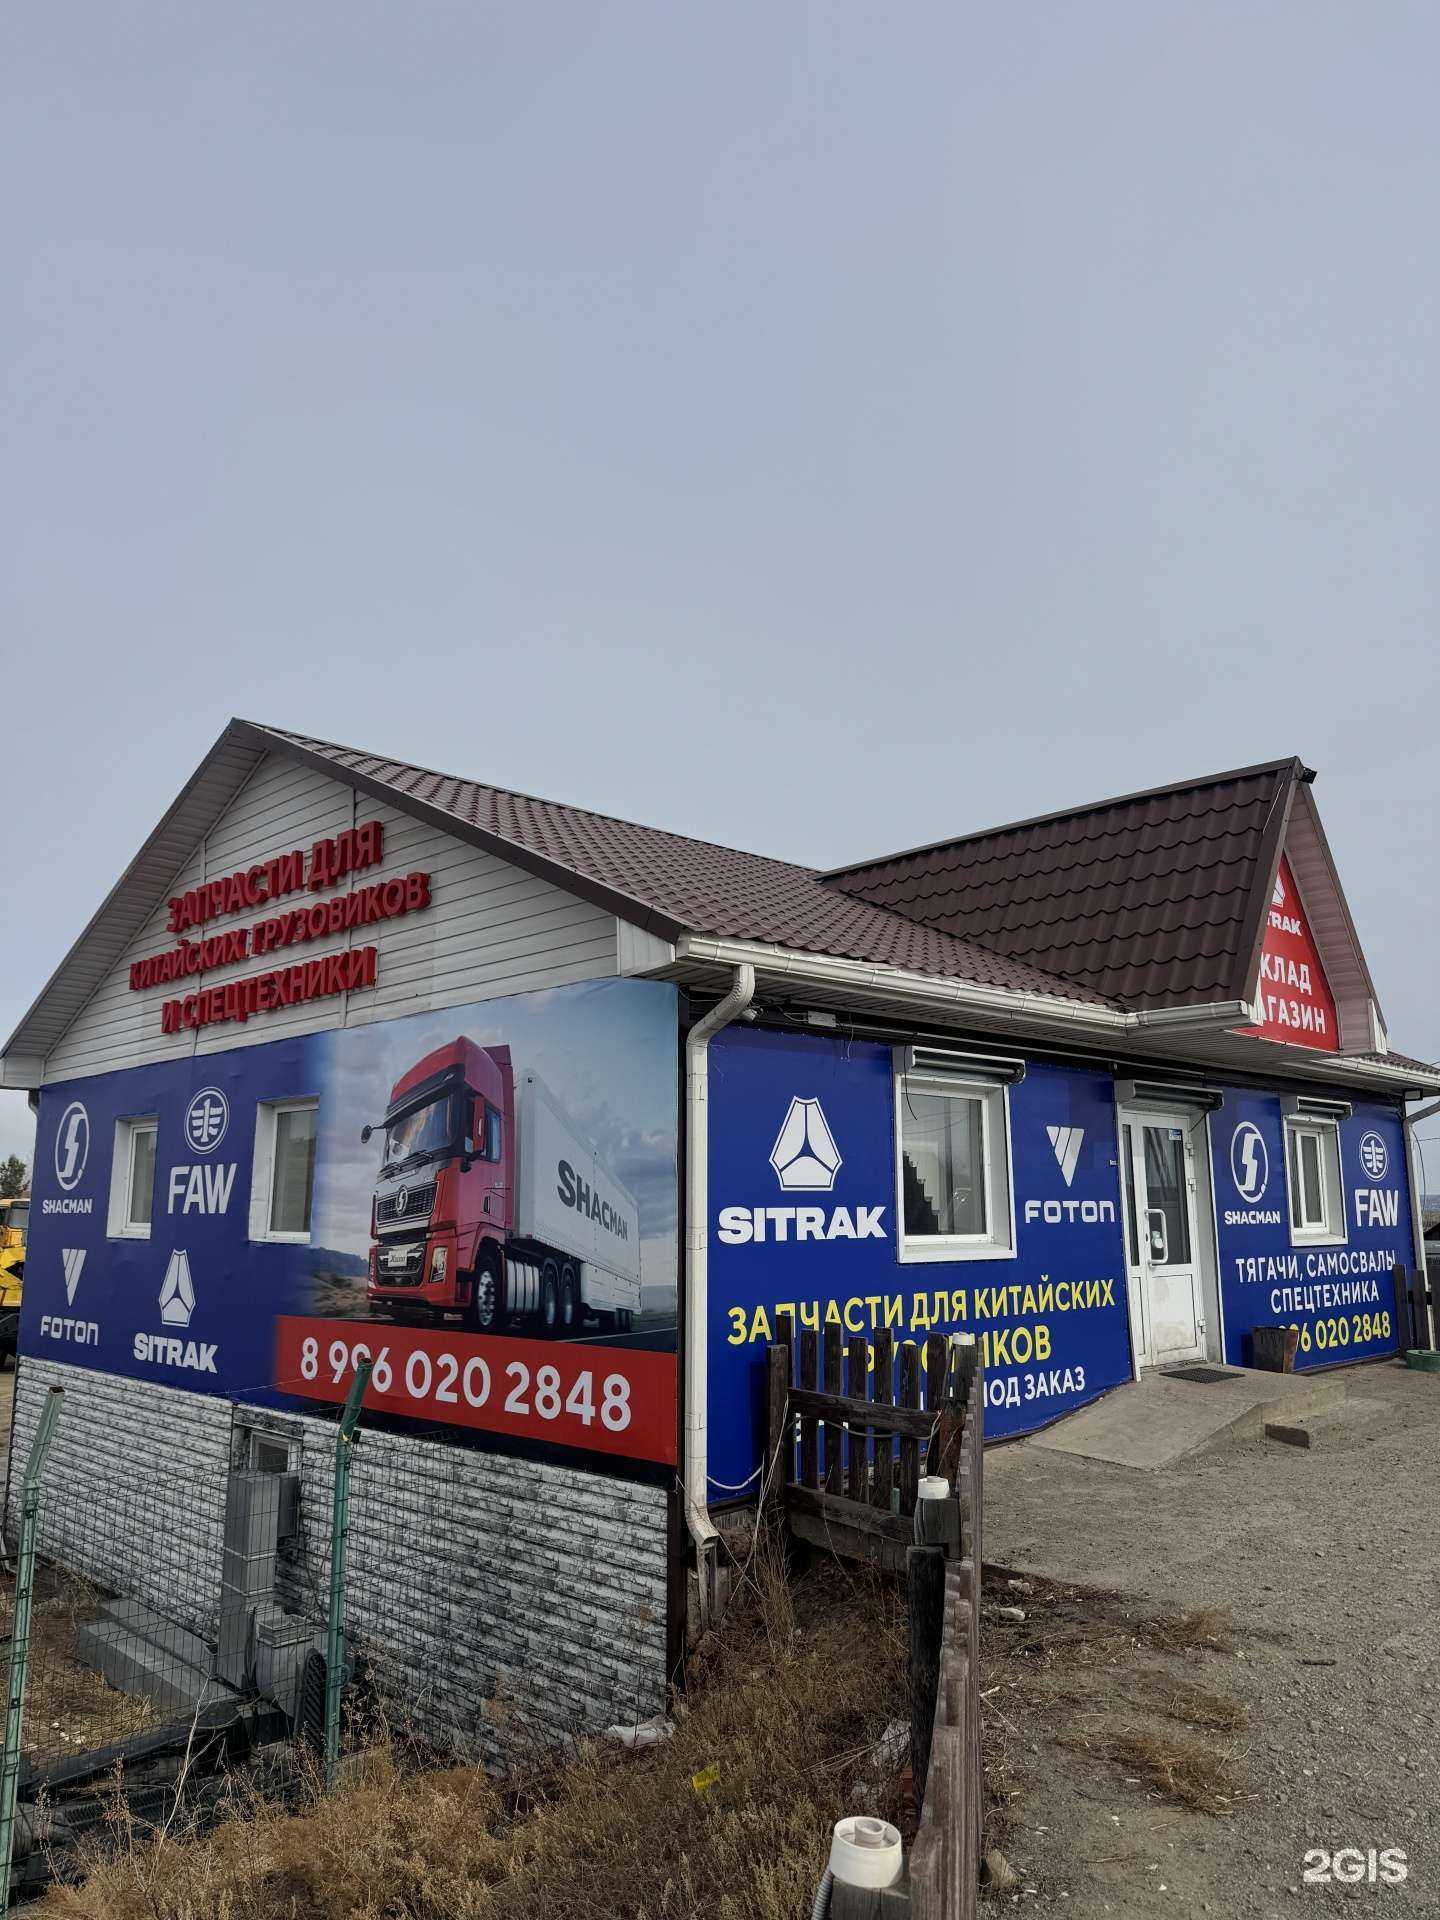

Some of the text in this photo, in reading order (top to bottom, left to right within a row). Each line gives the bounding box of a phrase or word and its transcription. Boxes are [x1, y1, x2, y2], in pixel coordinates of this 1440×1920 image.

[167, 821, 384, 932] ЗАПЧАСТИ ДЛЯ
[129, 872, 431, 990] КИТАЙСКИХ ГРУЗОВИКОВ
[162, 946, 378, 1034] И СПЕЦТЕХНИКИ
[1260, 951, 1312, 996] КЛАД
[1262, 995, 1326, 1034] ГАЗИН
[42, 1198, 92, 1214] SHACMAN
[167, 1163, 237, 1214] FAW
[557, 1159, 628, 1241] SHACMAN
[1354, 1189, 1399, 1227] FAW
[718, 1206, 888, 1244] SITRAK
[1024, 1200, 1115, 1224] FOTON
[1224, 1210, 1281, 1224] SHACMAN
[1235, 1249, 1396, 1282] ТЯГАЧИ, САМОСВАЛЫ
[910, 1289, 967, 1332] ДЛЯ
[974, 1275, 1116, 1319] КИТАЙСКИХ
[1270, 1279, 1380, 1314] СПЕЦТЕХНИКА
[40, 1316, 99, 1346] FOTON
[1315, 1316, 1349, 1350] 020
[1352, 1311, 1391, 1343] 2848
[133, 1332, 219, 1373] SITRAK
[301, 1336, 318, 1380] 8
[405, 1350, 491, 1408] 020
[504, 1361, 632, 1432] 2848
[1023, 1366, 1086, 1400] ЗАКАЗ
